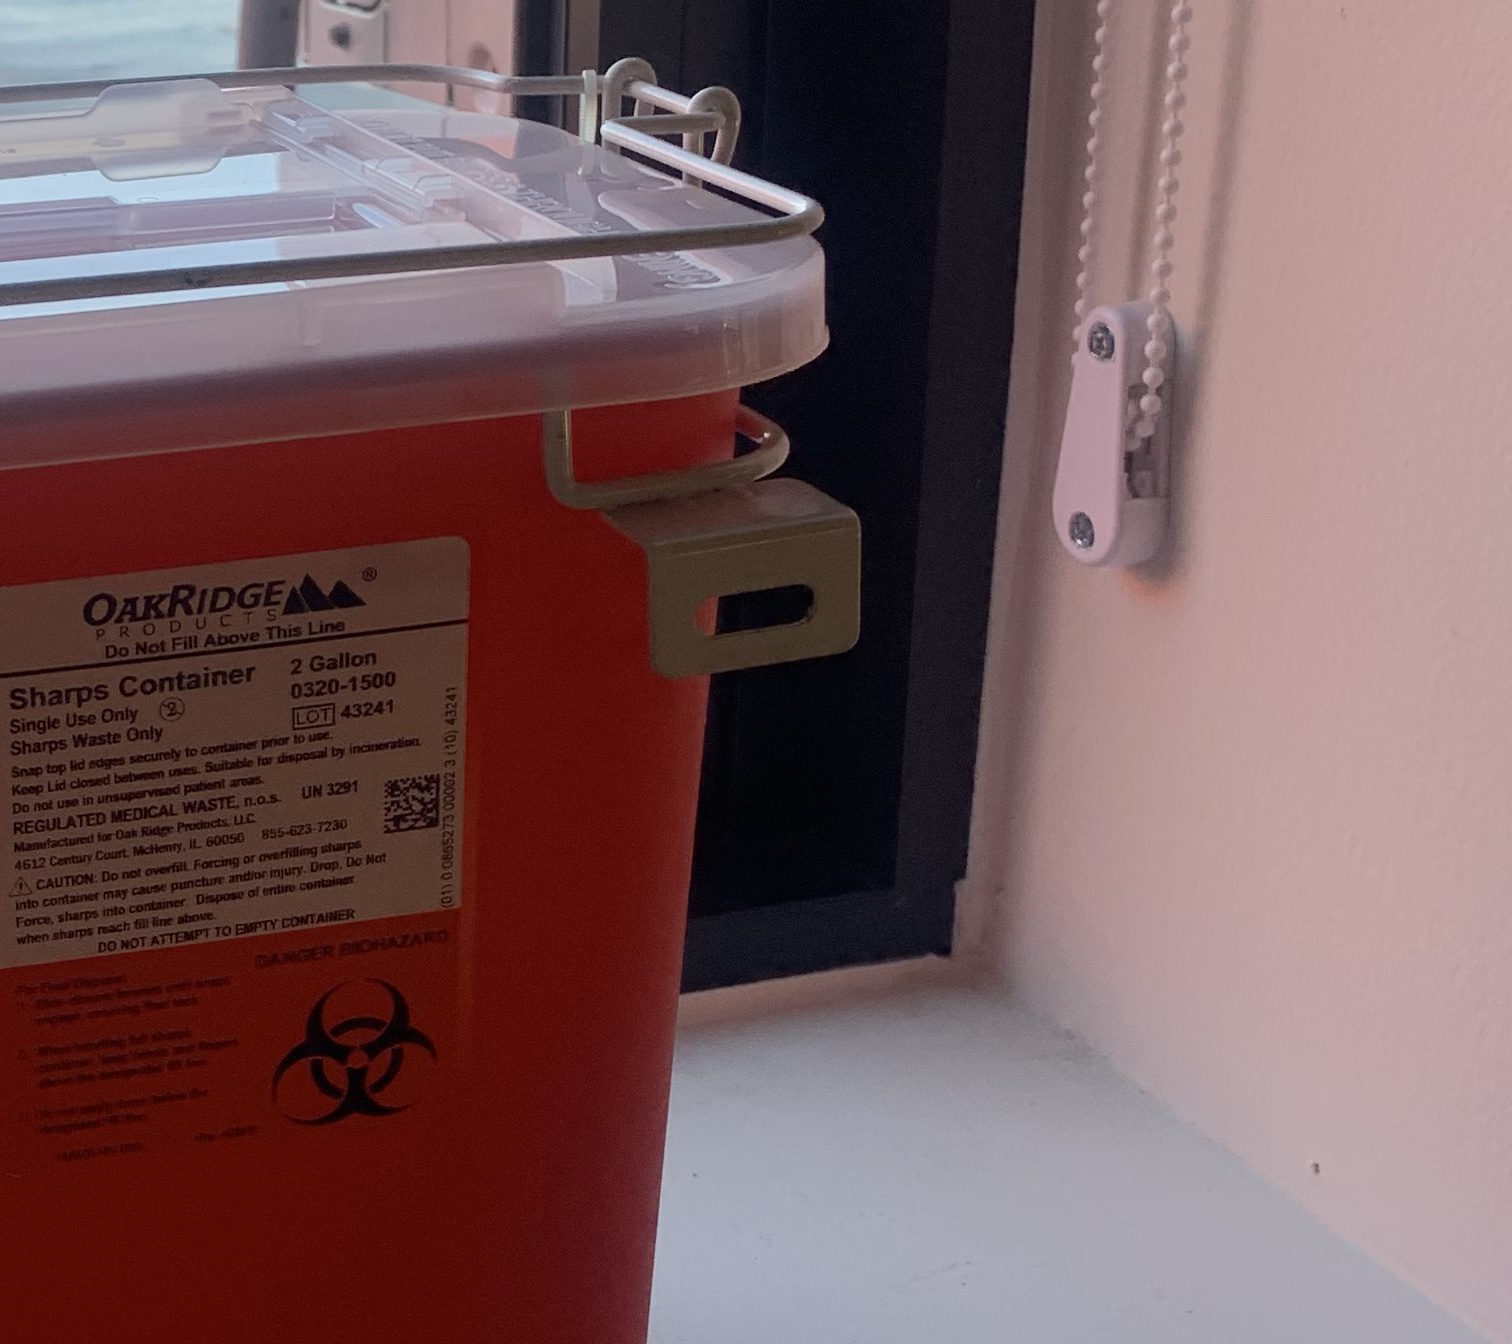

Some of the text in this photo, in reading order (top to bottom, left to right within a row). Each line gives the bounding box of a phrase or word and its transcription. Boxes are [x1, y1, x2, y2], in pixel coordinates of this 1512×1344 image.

[96, 610, 276, 638] PRODUCTS
[104, 620, 345, 659] Do Not Fill Above This Line
[289, 651, 377, 675] 2 Gallon
[7, 665, 256, 710] Sharps Container
[291, 672, 396, 698] 0320-1500
[9, 705, 139, 734] Single Use Only
[296, 698, 393, 725] LOT 43241
[445, 685, 457, 728] 43241
[9, 724, 164, 756] Sharps Waste Only
[10, 765, 43, 778] Snap
[45, 762, 67, 775] top
[69, 758, 85, 772] lid
[87, 756, 126, 770] edges
[128, 747, 181, 764] securely
[184, 746, 198, 757] to
[199, 739, 258, 756] container
[260, 734, 290, 751] prior
[293, 732, 305, 744] to
[444, 729, 457, 756] (10)
[11, 783, 43, 796] Keep
[47, 778, 66, 792] Lid
[69, 773, 110, 789] closed
[113, 769, 164, 784] between
[204, 756, 254, 773] Suitable
[256, 754, 274, 767] for
[276, 746, 328, 764] disposal
[330, 745, 345, 760] by
[444, 758, 455, 768] 3
[11, 801, 29, 815] Do
[33, 798, 53, 811] not
[56, 797, 79, 809] use
[81, 794, 93, 806] in
[96, 783, 180, 804] unsupervised
[183, 778, 225, 796] patient
[12, 811, 106, 835] REGULATED
[110, 802, 178, 823] MEDICAL
[243, 793, 281, 807] n.o.s.
[300, 783, 323, 799] UN
[326, 779, 358, 796] 3291
[13, 833, 94, 853] Manufactured
[96, 831, 112, 842] for
[114, 828, 137, 840] Oak
[140, 824, 174, 837] Ridge
[14, 856, 46, 871] 4612
[49, 853, 92, 867] Century
[261, 818, 347, 840] 855-623-7230
[100, 870, 119, 882] Do
[121, 867, 142, 879] not
[192, 855, 240, 870] Forcing
[242, 854, 255, 864] or
[258, 845, 318, 862] overfilling
[320, 839, 362, 854] sharps
[441, 871, 452, 881] 0
[15, 898, 39, 911] into
[41, 891, 99, 907] container
[102, 888, 128, 900] may
[131, 883, 167, 896] cause
[169, 875, 224, 894] puncture
[228, 870, 267, 883] and/or
[345, 856, 362, 867] Do
[365, 852, 387, 865] Not
[57, 909, 99, 923] sharps
[102, 905, 125, 917] into
[195, 890, 244, 905] Dispose
[247, 885, 259, 898] of
[262, 883, 295, 896] entire
[299, 875, 355, 891] container
[15, 932, 49, 945] when
[50, 927, 94, 940] sharps
[97, 920, 130, 935] reach
[133, 917, 149, 930] fill
[151, 915, 173, 927] line
[97, 907, 356, 953] DO NOT ATTEMPT TO EMPTY CONTAINER
